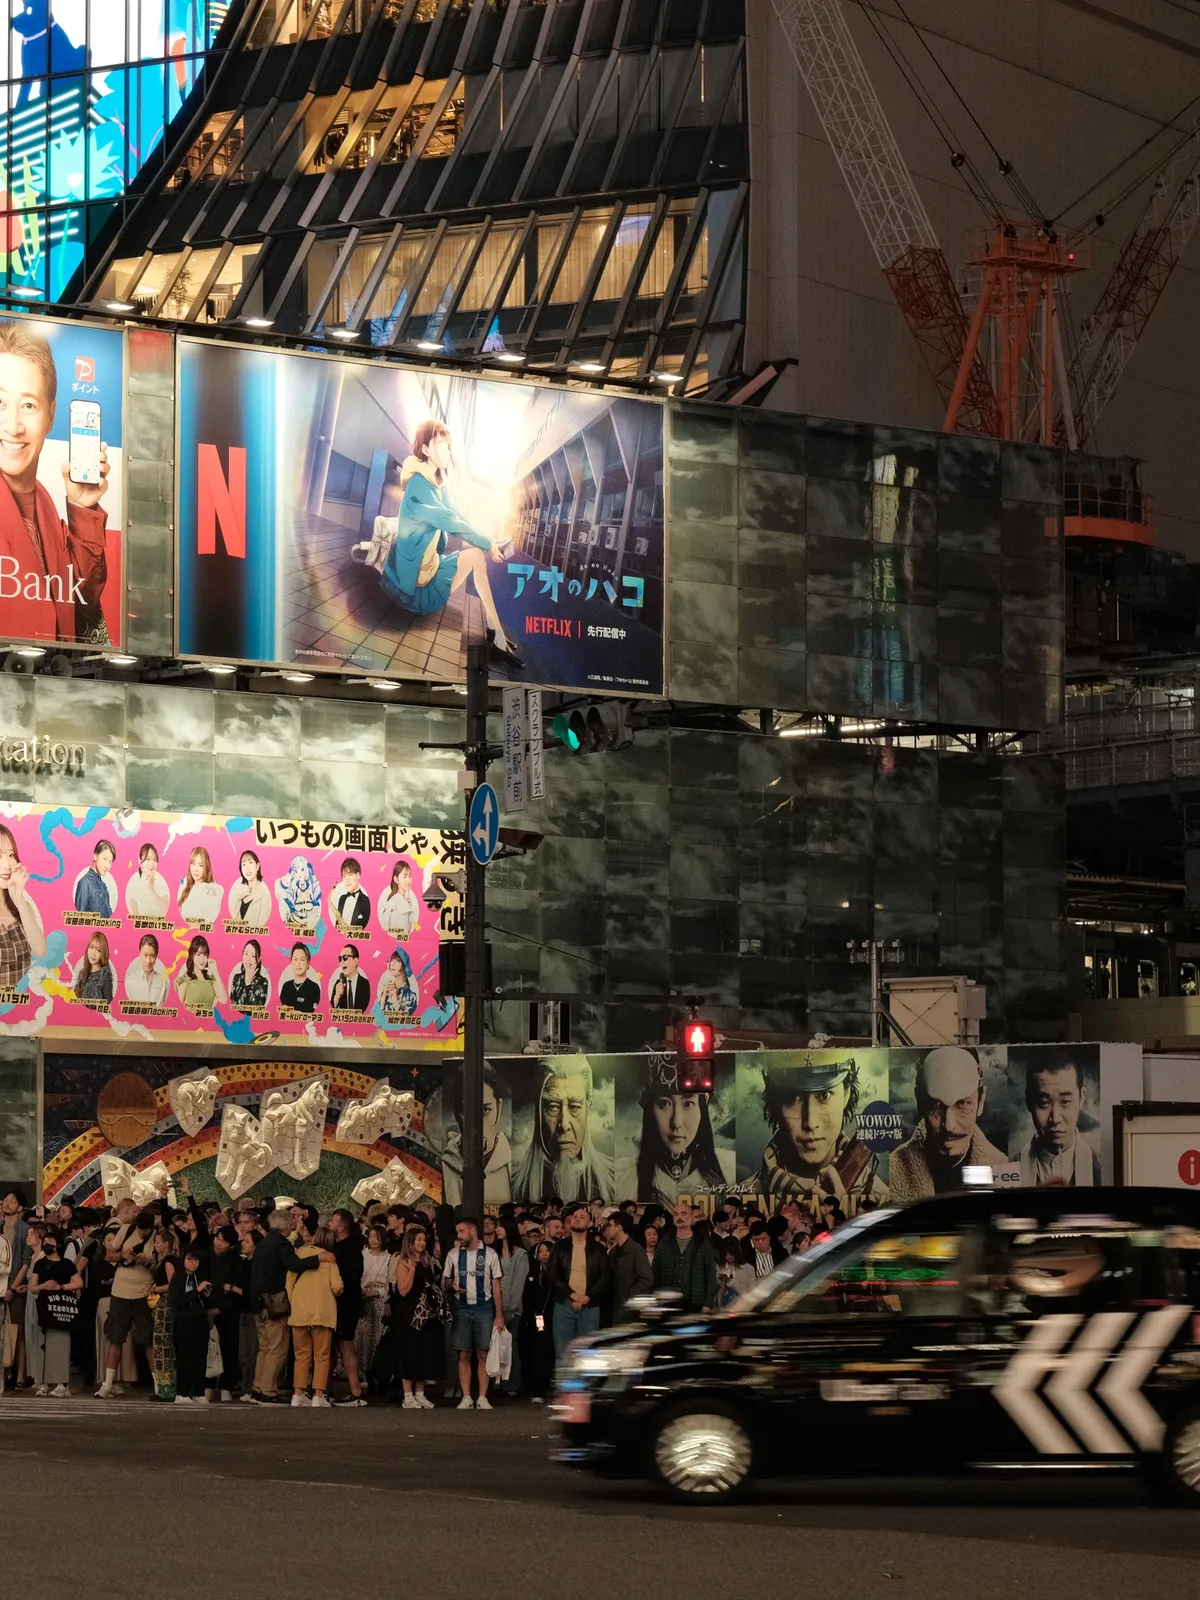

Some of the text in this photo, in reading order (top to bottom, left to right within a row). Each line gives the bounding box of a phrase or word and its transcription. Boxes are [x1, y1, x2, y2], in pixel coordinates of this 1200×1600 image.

[71, 382, 99, 394] ポイント
[197, 443, 247, 559] N
[507, 563, 645, 608] アオのハコ
[525, 616, 571, 637] NETFLIX
[587, 625, 626, 640] 先行配信中
[511, 696, 523, 803] 渋谷駅前
[256, 820, 438, 855] いつもの画面じゃ、
[253, 1011, 269, 1019] mike
[855, 1114, 903, 1127] WOWOW
[856, 1128, 903, 1140] 連続ドラマ版
[696, 1184, 754, 1193] ゴールデンカムイ
[48, 1304, 78, 1313] RECORDS
